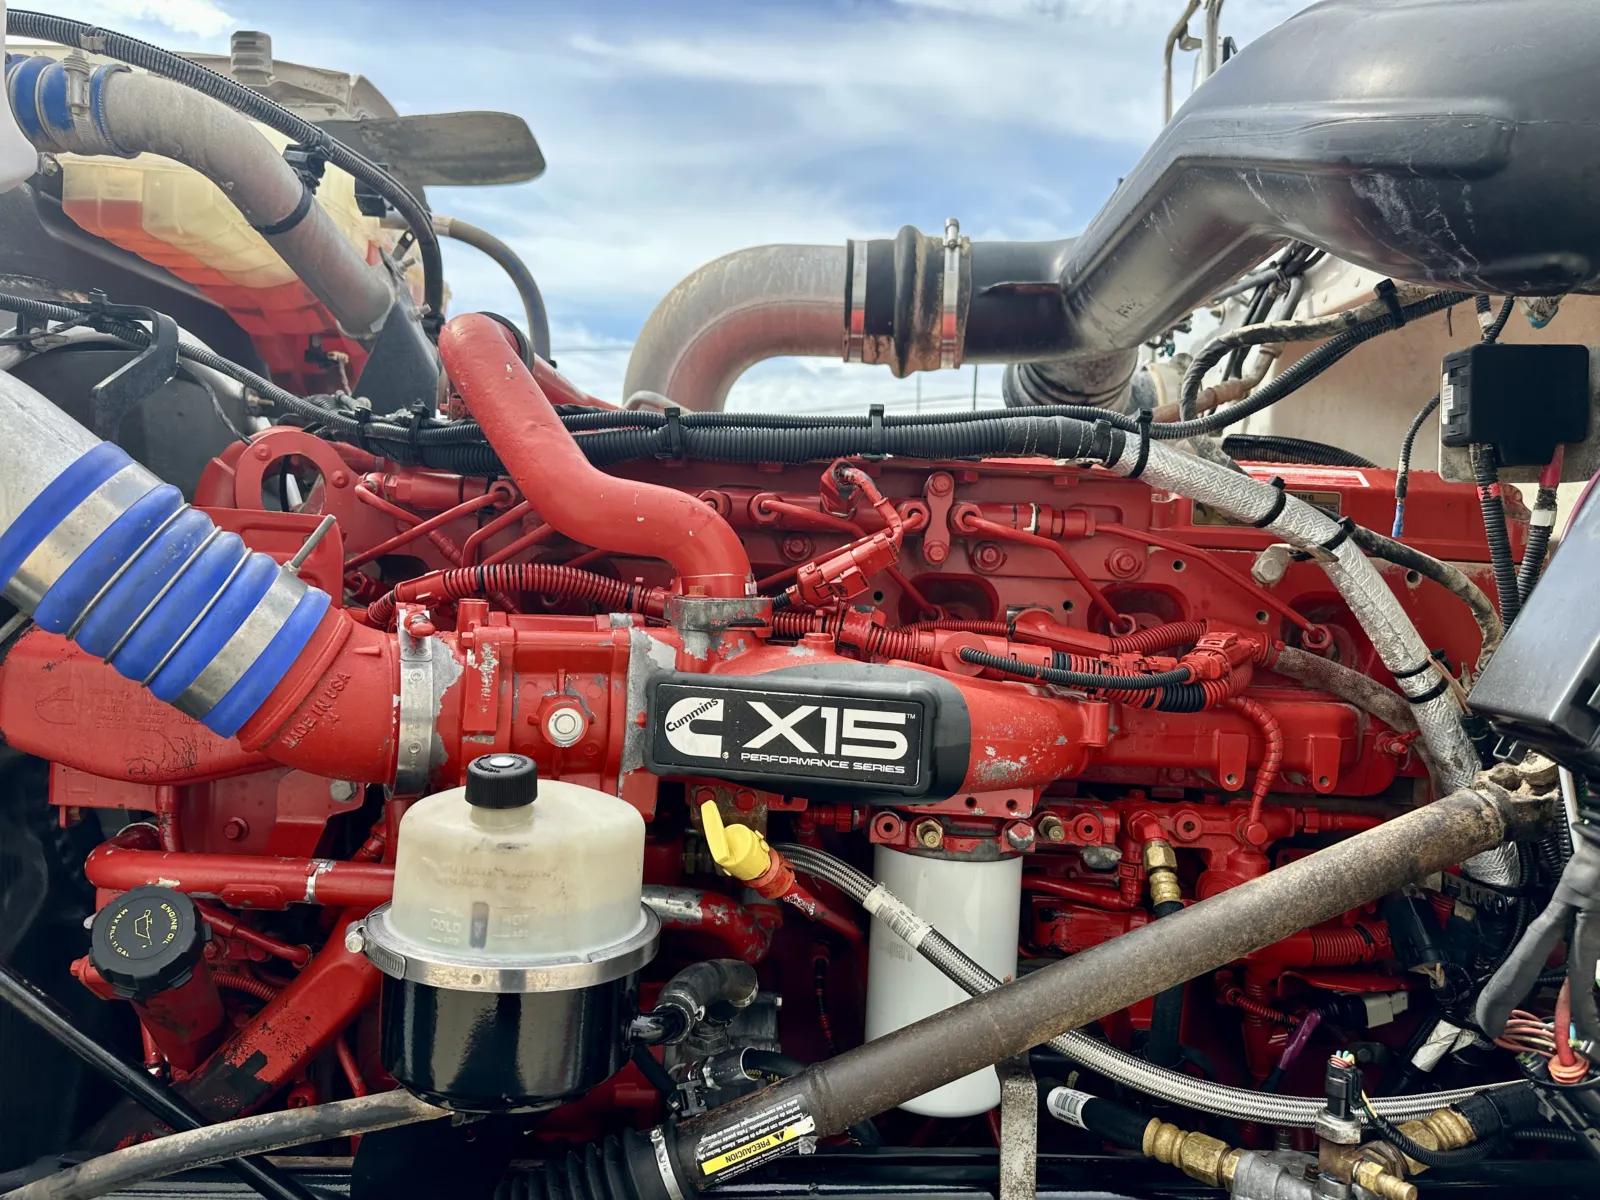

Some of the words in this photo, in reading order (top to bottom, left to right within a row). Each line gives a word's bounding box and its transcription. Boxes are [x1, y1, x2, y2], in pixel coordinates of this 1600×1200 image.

[281, 714, 316, 749] MADE
[312, 698, 332, 717] IN
[326, 673, 351, 699] USA
[665, 698, 719, 733] Cummins
[740, 752, 849, 770] PERFORMANCE
[852, 762, 906, 775] SERIES
[114, 908, 128, 923] MAX
[160, 903, 178, 930] ENGINE
[430, 918, 461, 934] COLD
[162, 932, 174, 944] OIL
[726, 1139, 770, 1163] PRECAUCION
